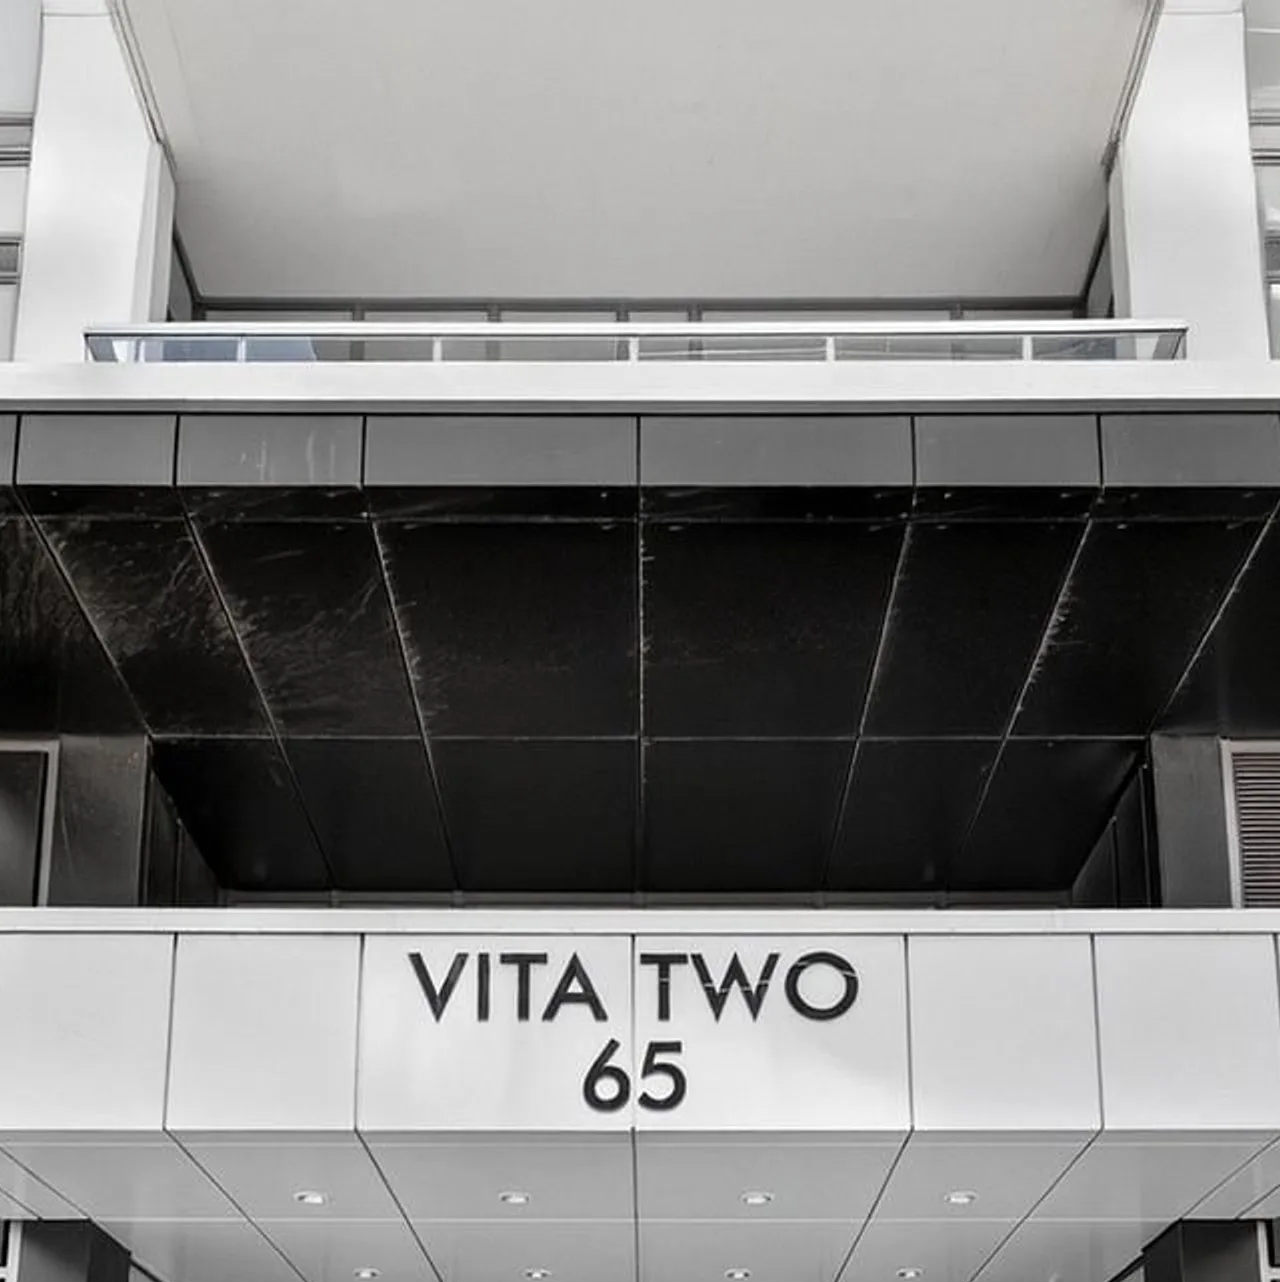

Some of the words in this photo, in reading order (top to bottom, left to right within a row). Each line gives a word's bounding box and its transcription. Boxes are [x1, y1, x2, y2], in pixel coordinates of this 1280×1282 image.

[407, 951, 609, 1022] VITA
[639, 951, 859, 1022] TWO
[582, 1038, 687, 1112] 65
